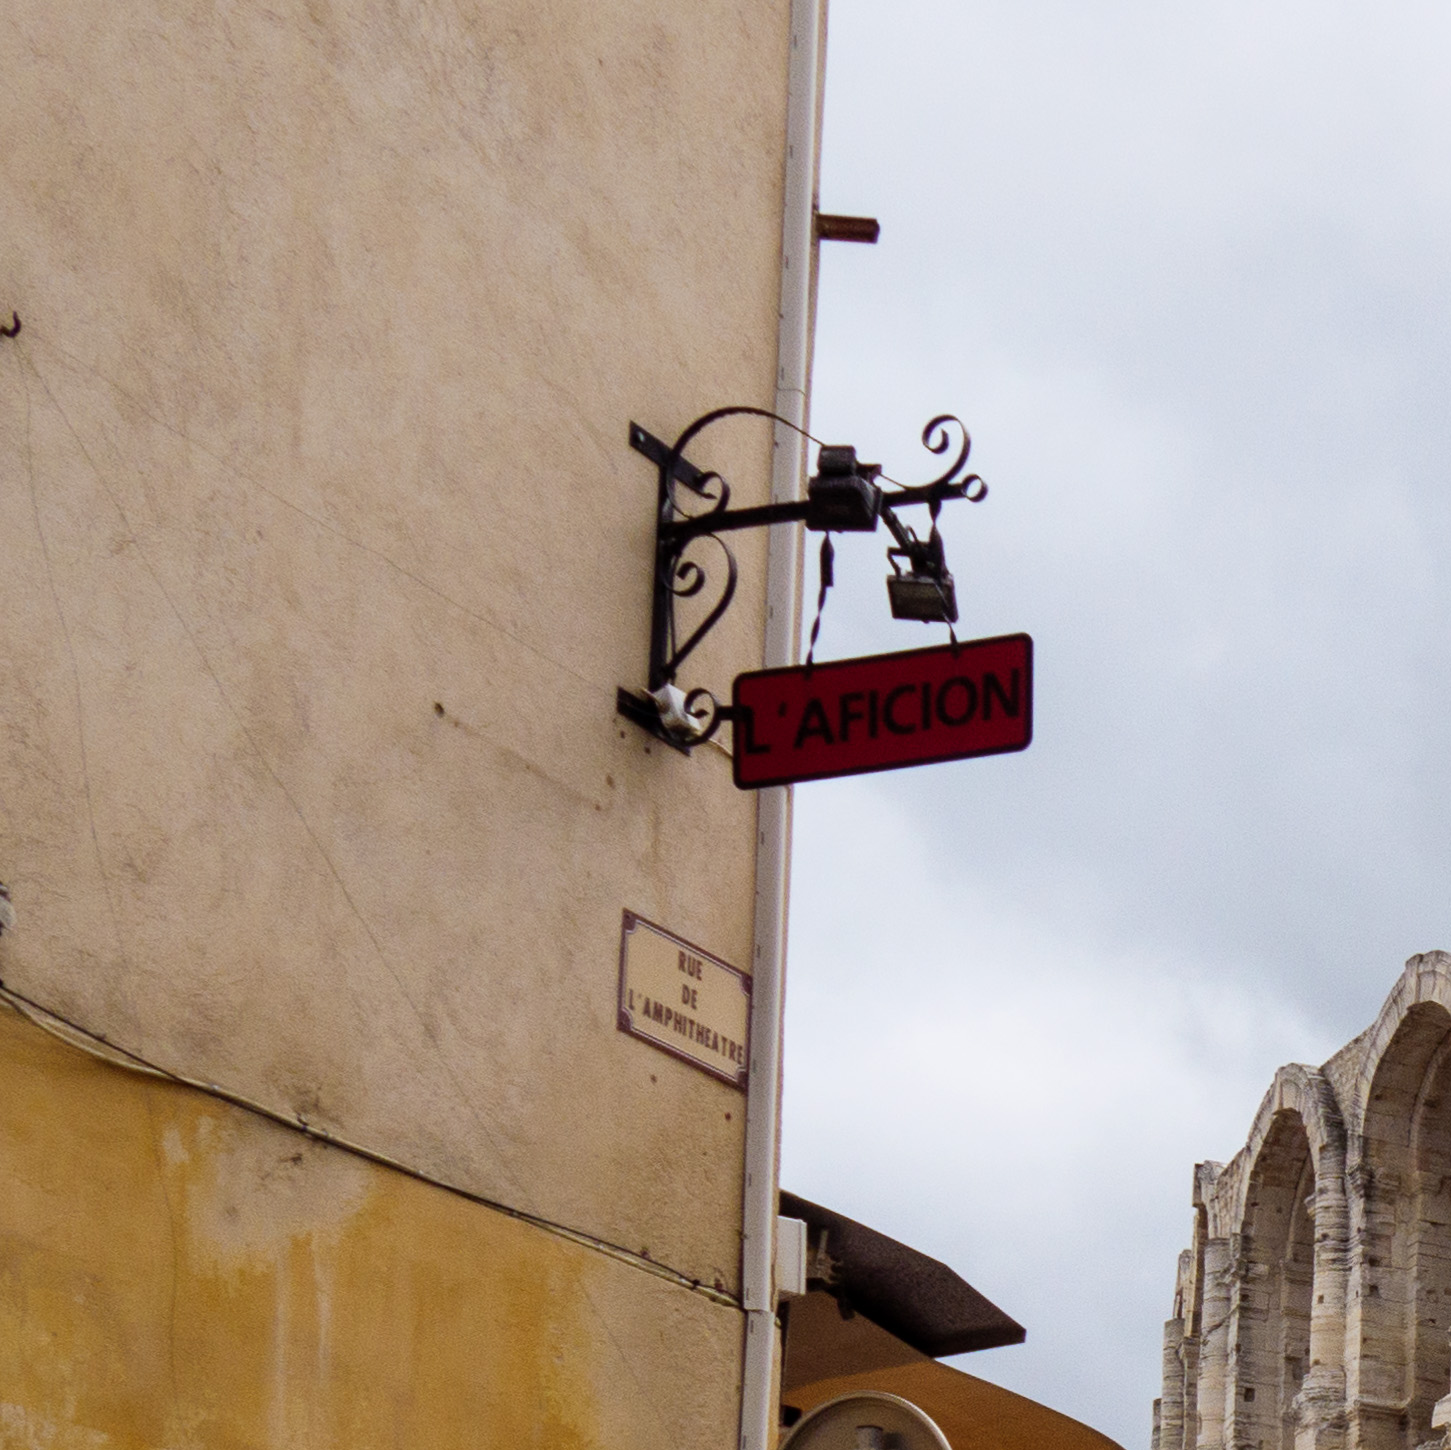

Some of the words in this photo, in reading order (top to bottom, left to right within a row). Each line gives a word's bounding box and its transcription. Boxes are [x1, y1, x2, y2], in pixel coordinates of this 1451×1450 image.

[744, 667, 1020, 755] L'AFICION
[678, 950, 703, 981] RUE
[681, 984, 698, 1010] DE
[628, 988, 744, 1065] L'AMPHITHEATRE
